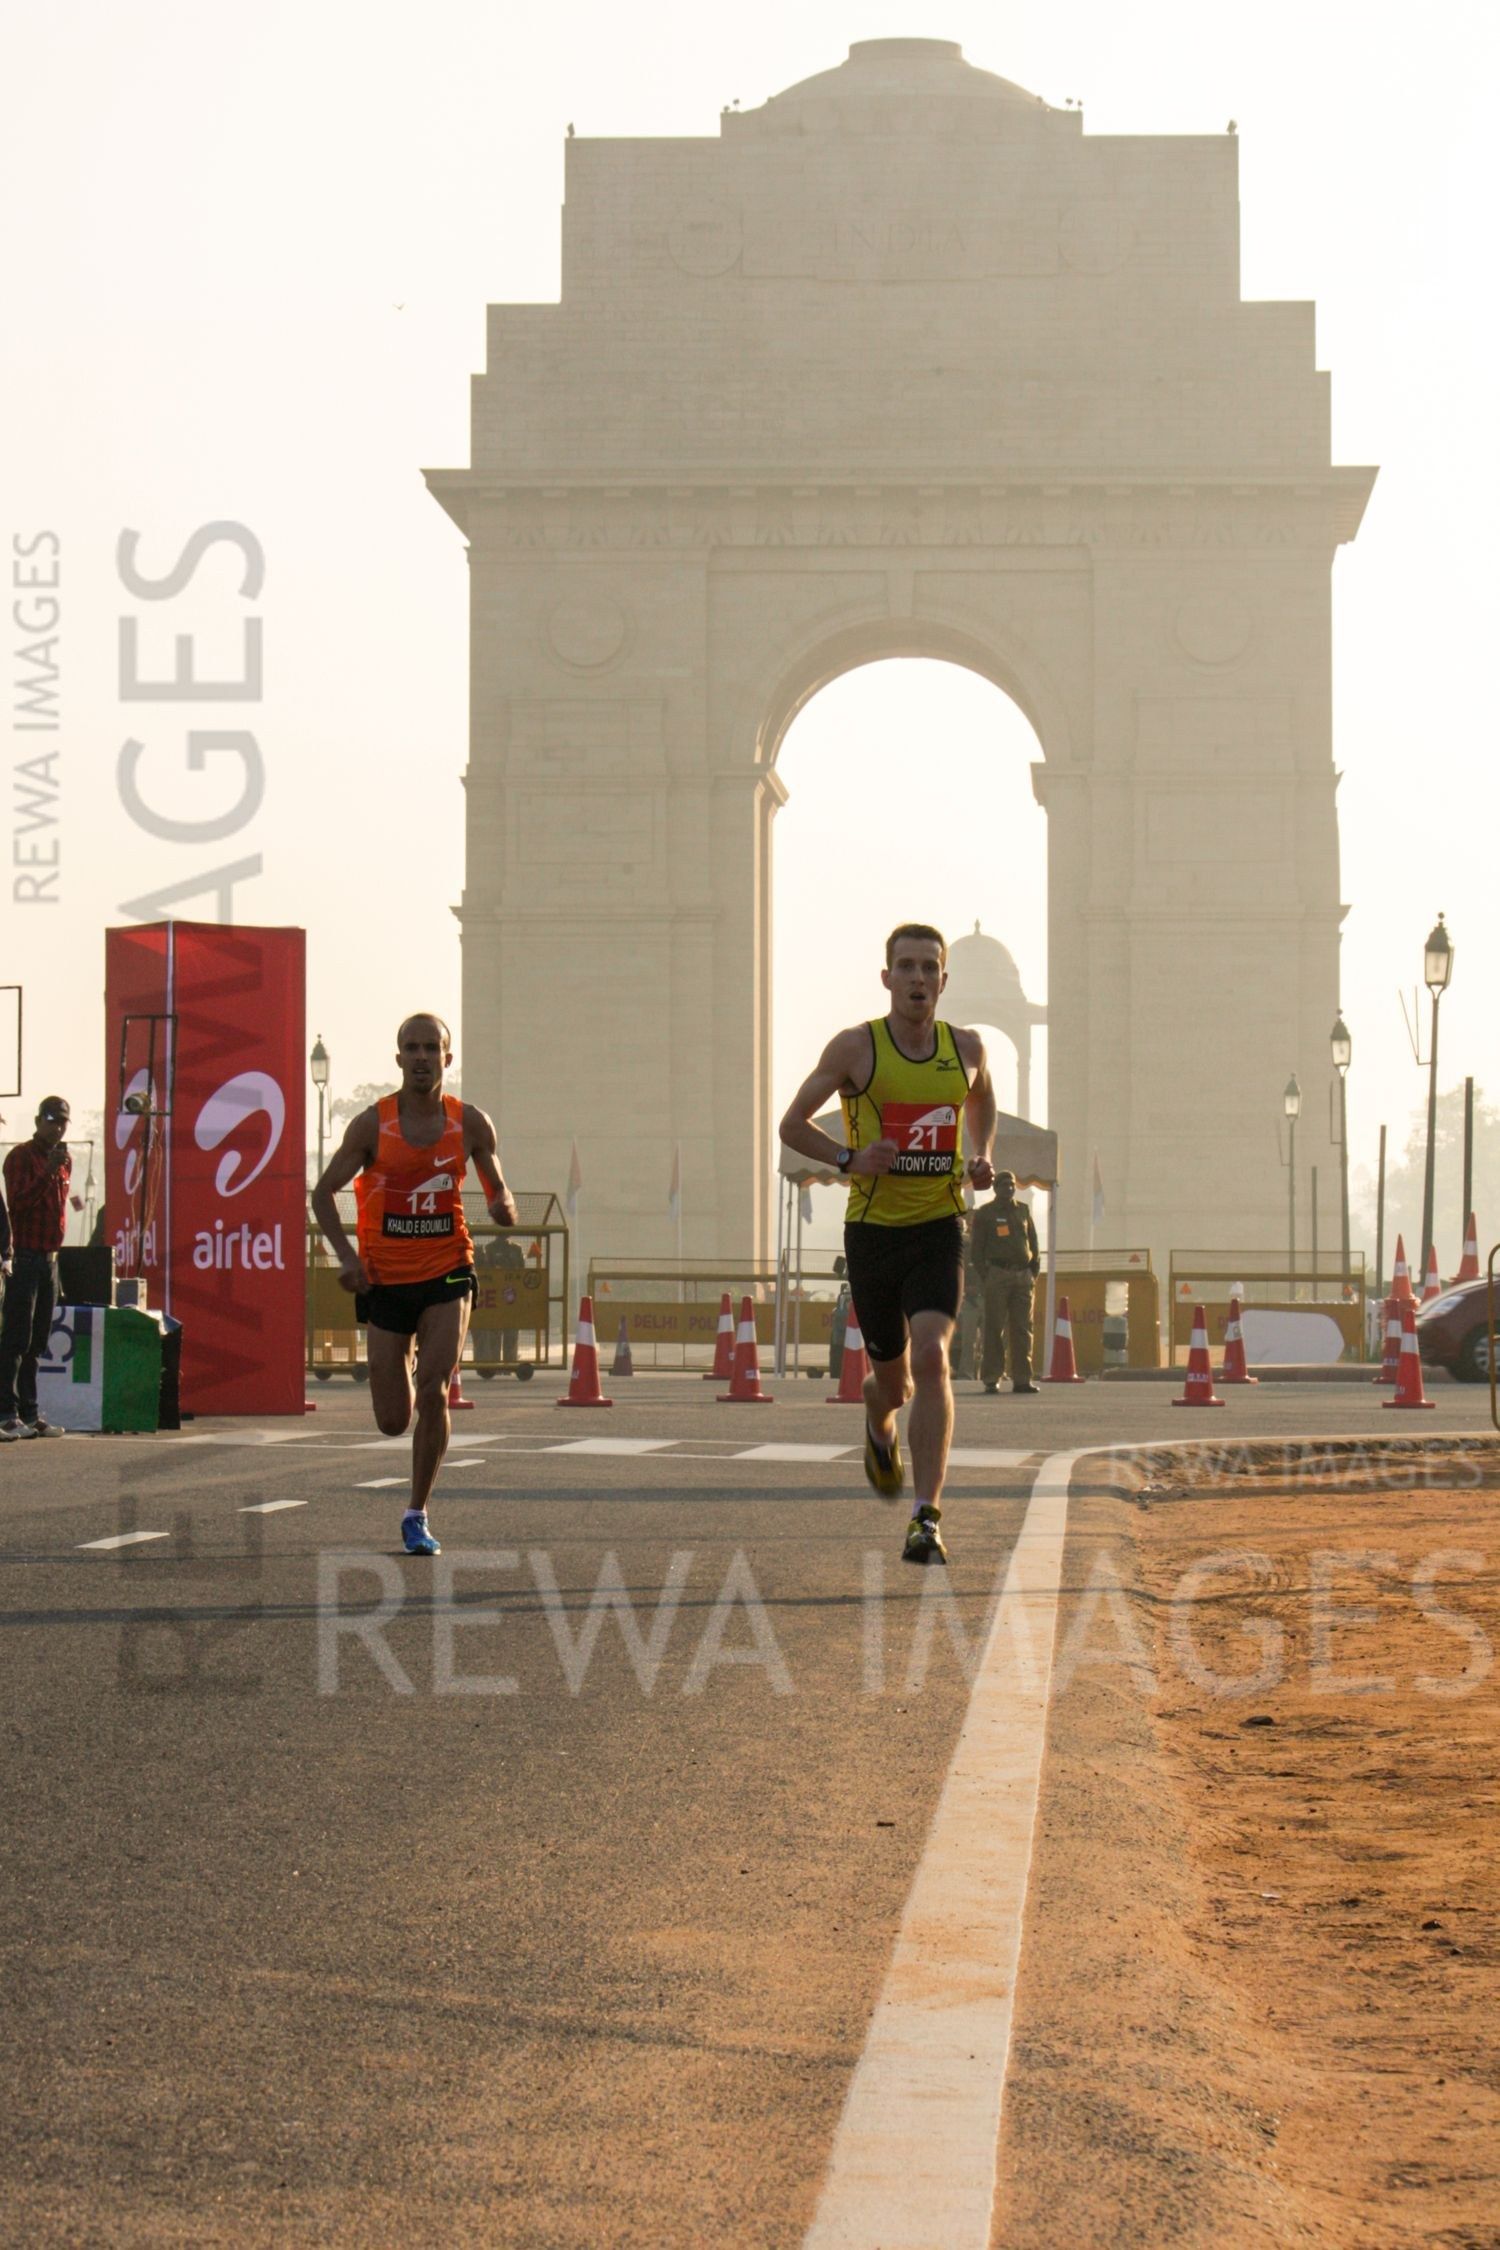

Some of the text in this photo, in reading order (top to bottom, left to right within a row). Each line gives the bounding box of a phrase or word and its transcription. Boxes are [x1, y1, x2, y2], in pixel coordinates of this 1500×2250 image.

[832, 223, 967, 253] INDIA
[908, 1126, 938, 1150] 21
[929, 1156, 952, 1171] FORD
[407, 1192, 437, 1214] 14
[388, 1217, 414, 1234] KHALID
[414, 1220, 420, 1233] E
[193, 1219, 285, 1270] airtel
[633, 1313, 678, 1329] DELHI
